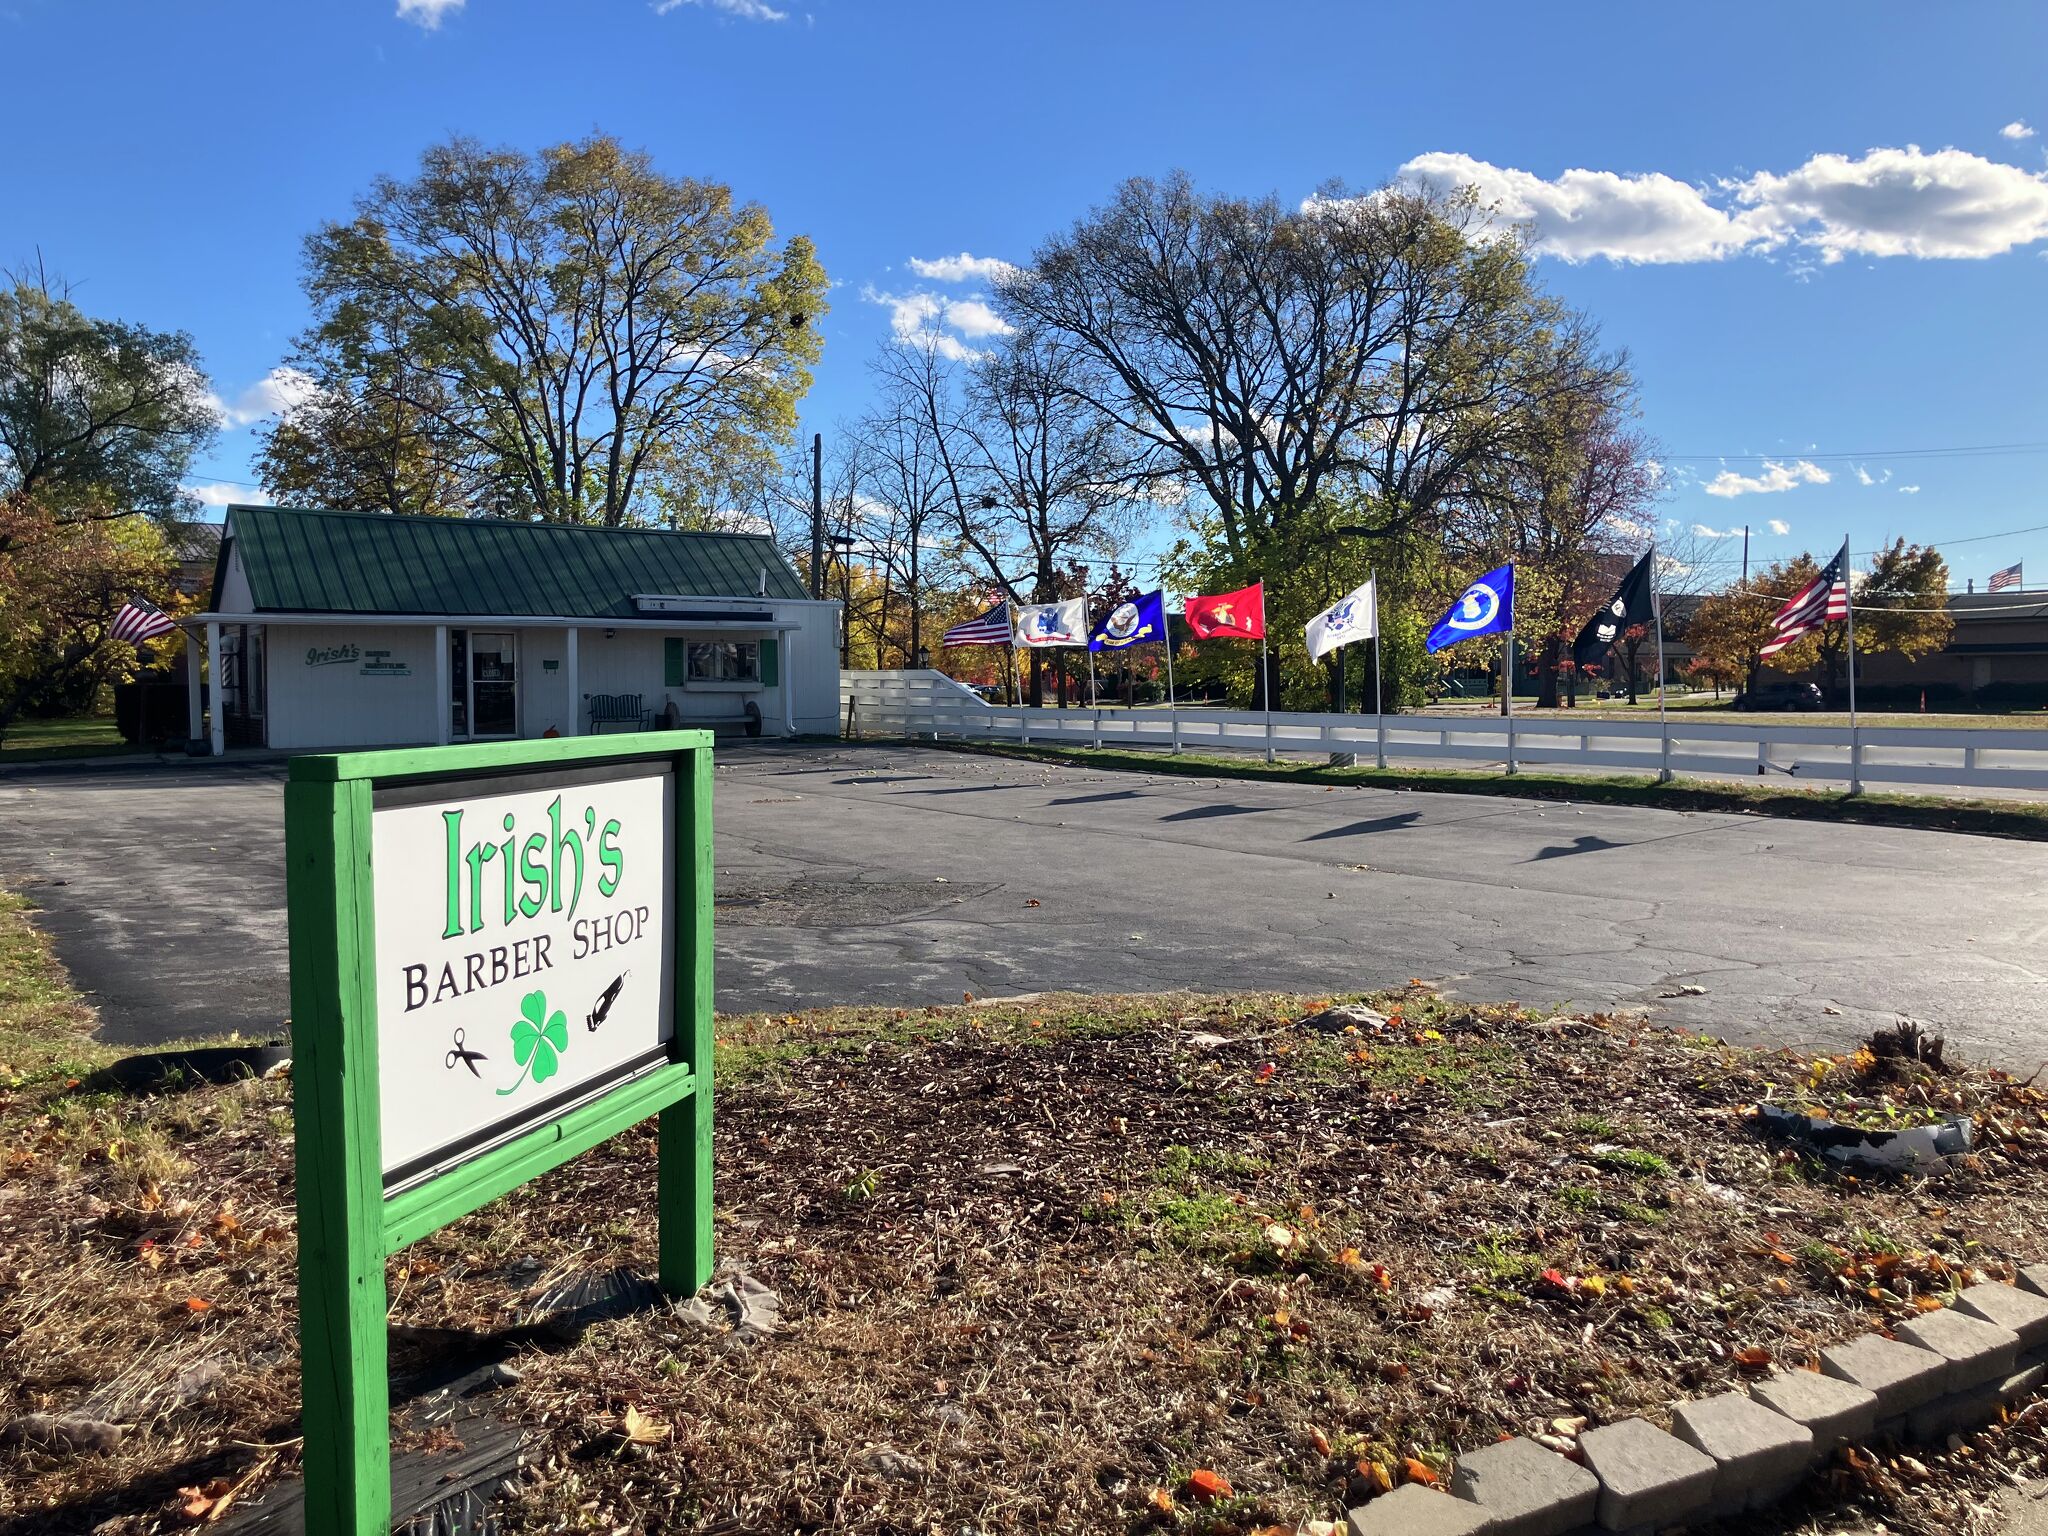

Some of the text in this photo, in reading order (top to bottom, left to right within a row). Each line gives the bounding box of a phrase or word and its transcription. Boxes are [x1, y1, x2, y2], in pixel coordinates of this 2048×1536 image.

[441, 794, 624, 940] Irish's
[402, 905, 650, 1013] BARBER SHOP
